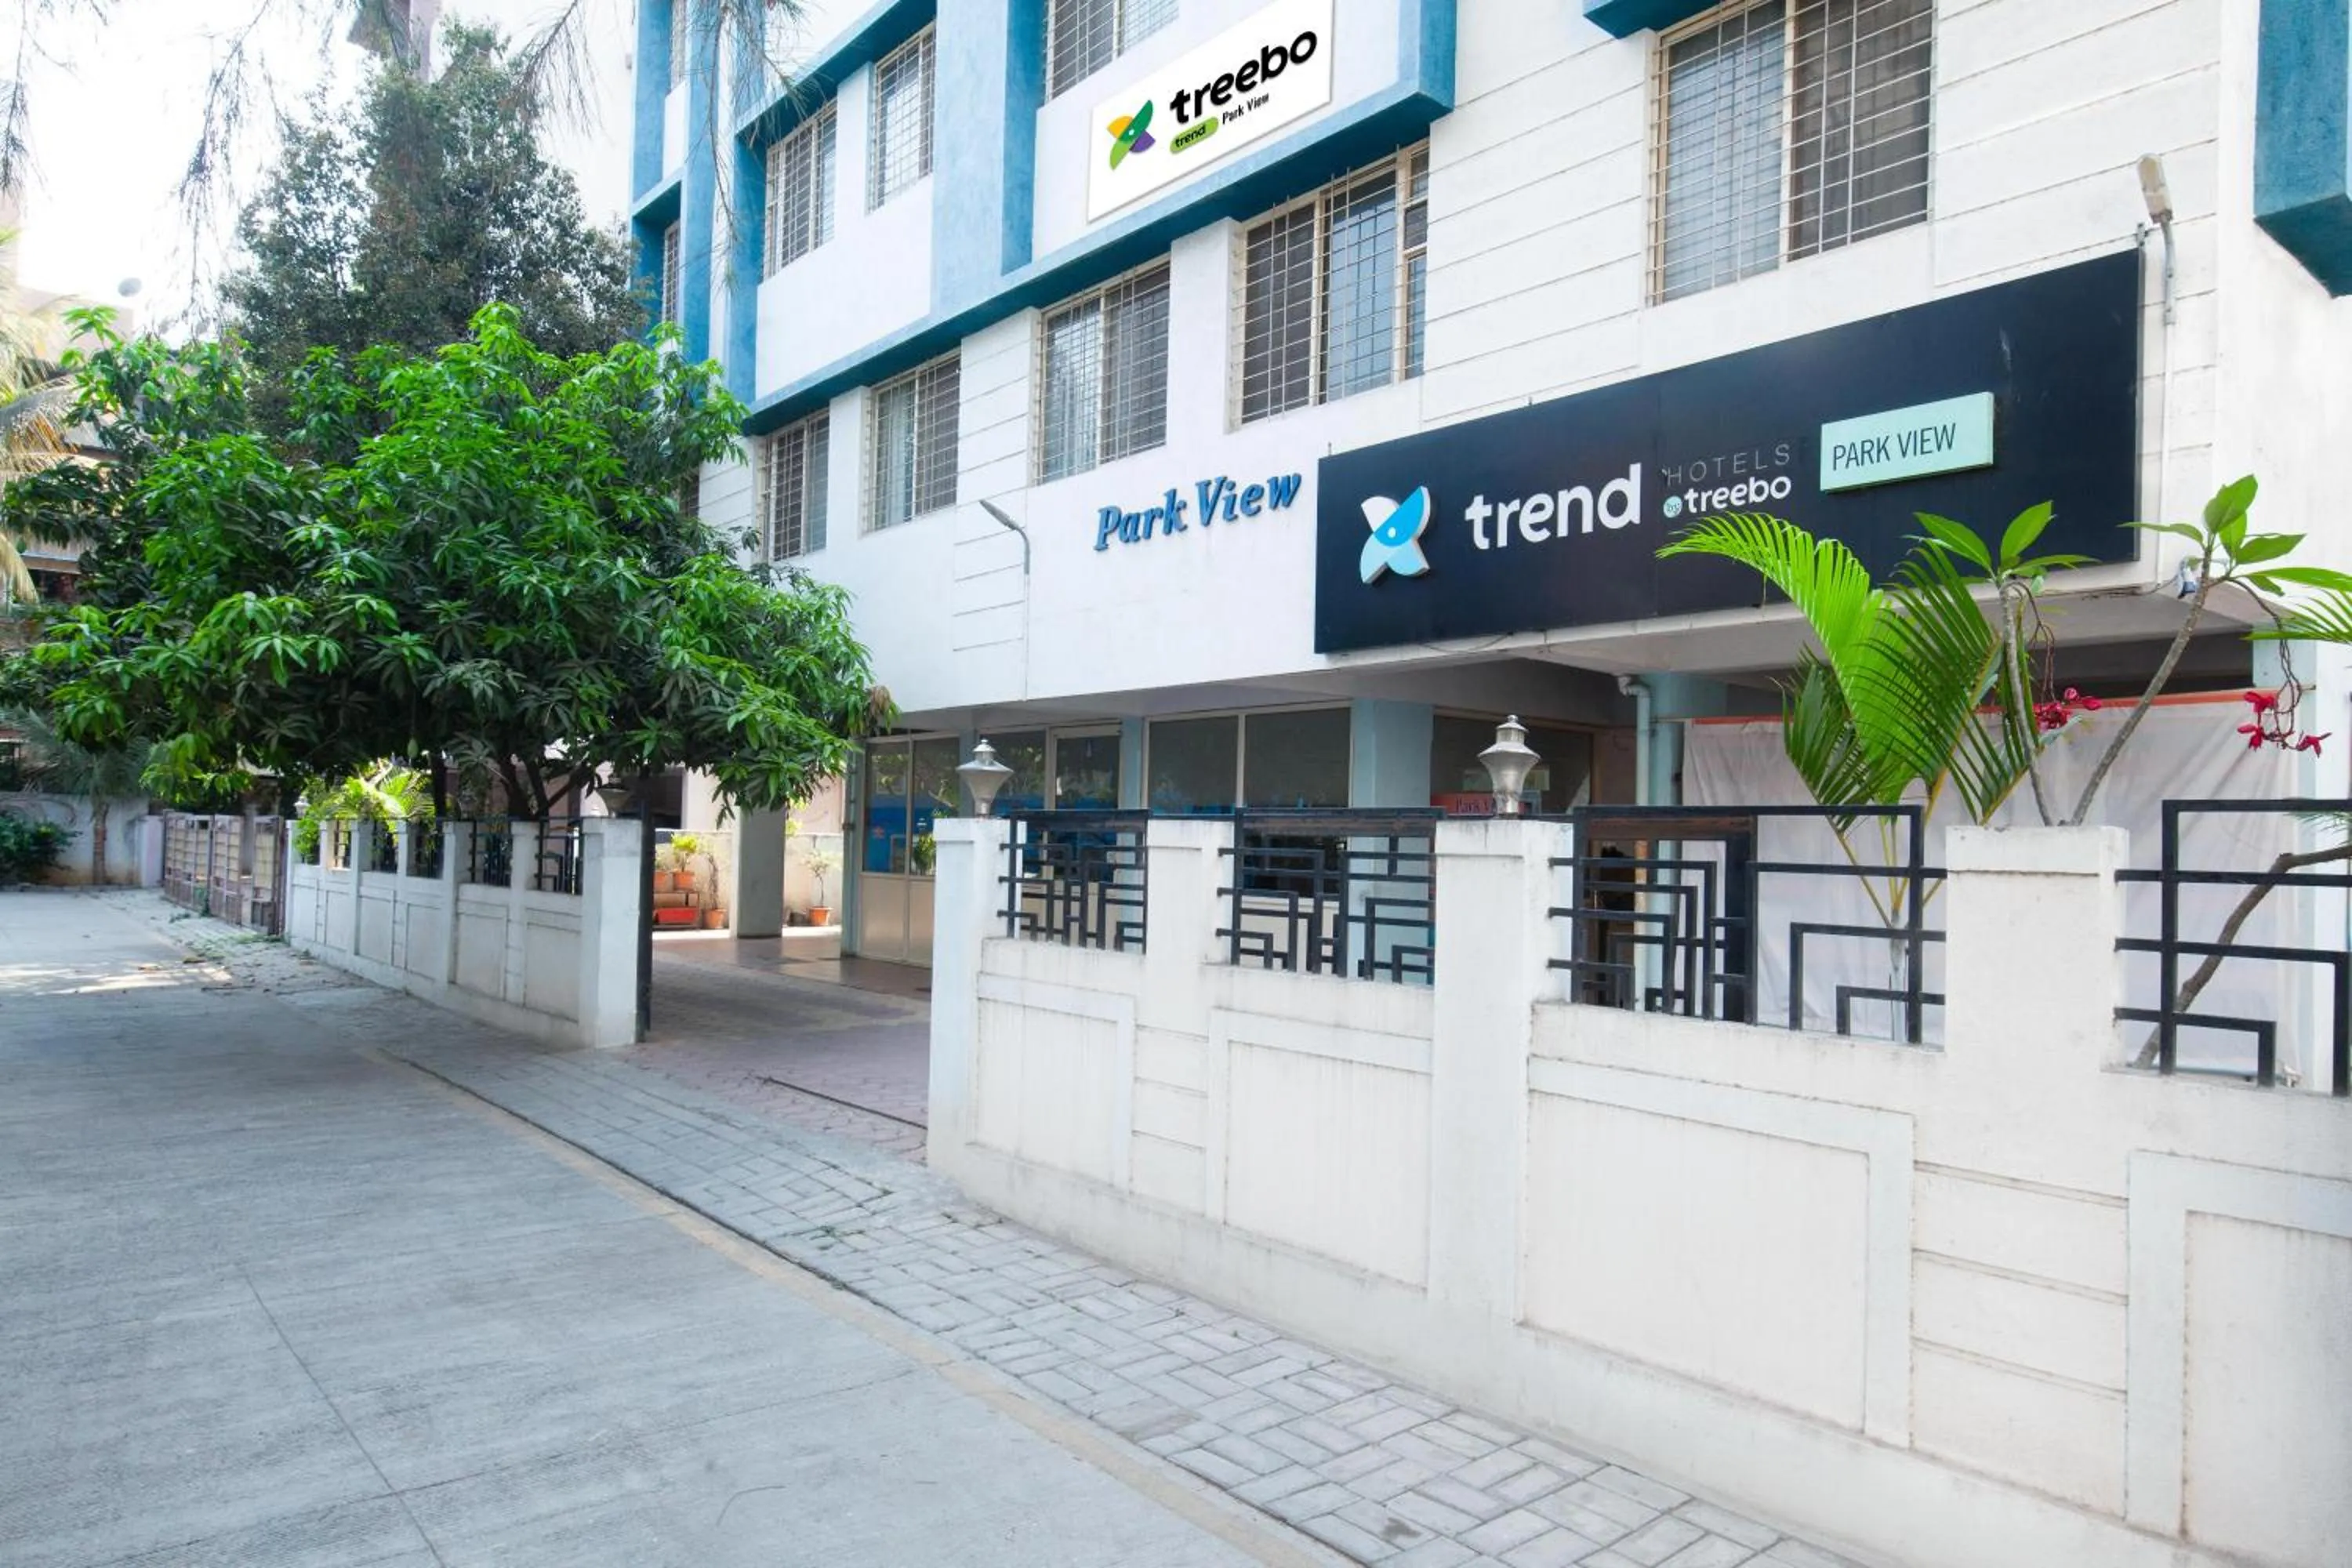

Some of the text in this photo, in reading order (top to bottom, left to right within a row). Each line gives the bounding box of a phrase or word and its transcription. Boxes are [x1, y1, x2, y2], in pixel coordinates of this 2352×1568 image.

[1170, 31, 1318, 124] treebo
[1222, 93, 1269, 125] Park View
[1174, 123, 1207, 147] trend
[1667, 443, 1791, 487] HOTELS
[1832, 422, 1956, 471] PARK VIEW
[1094, 473, 1301, 551] Park View
[1465, 463, 1642, 550] trend
[1684, 476, 1792, 514] treebo
